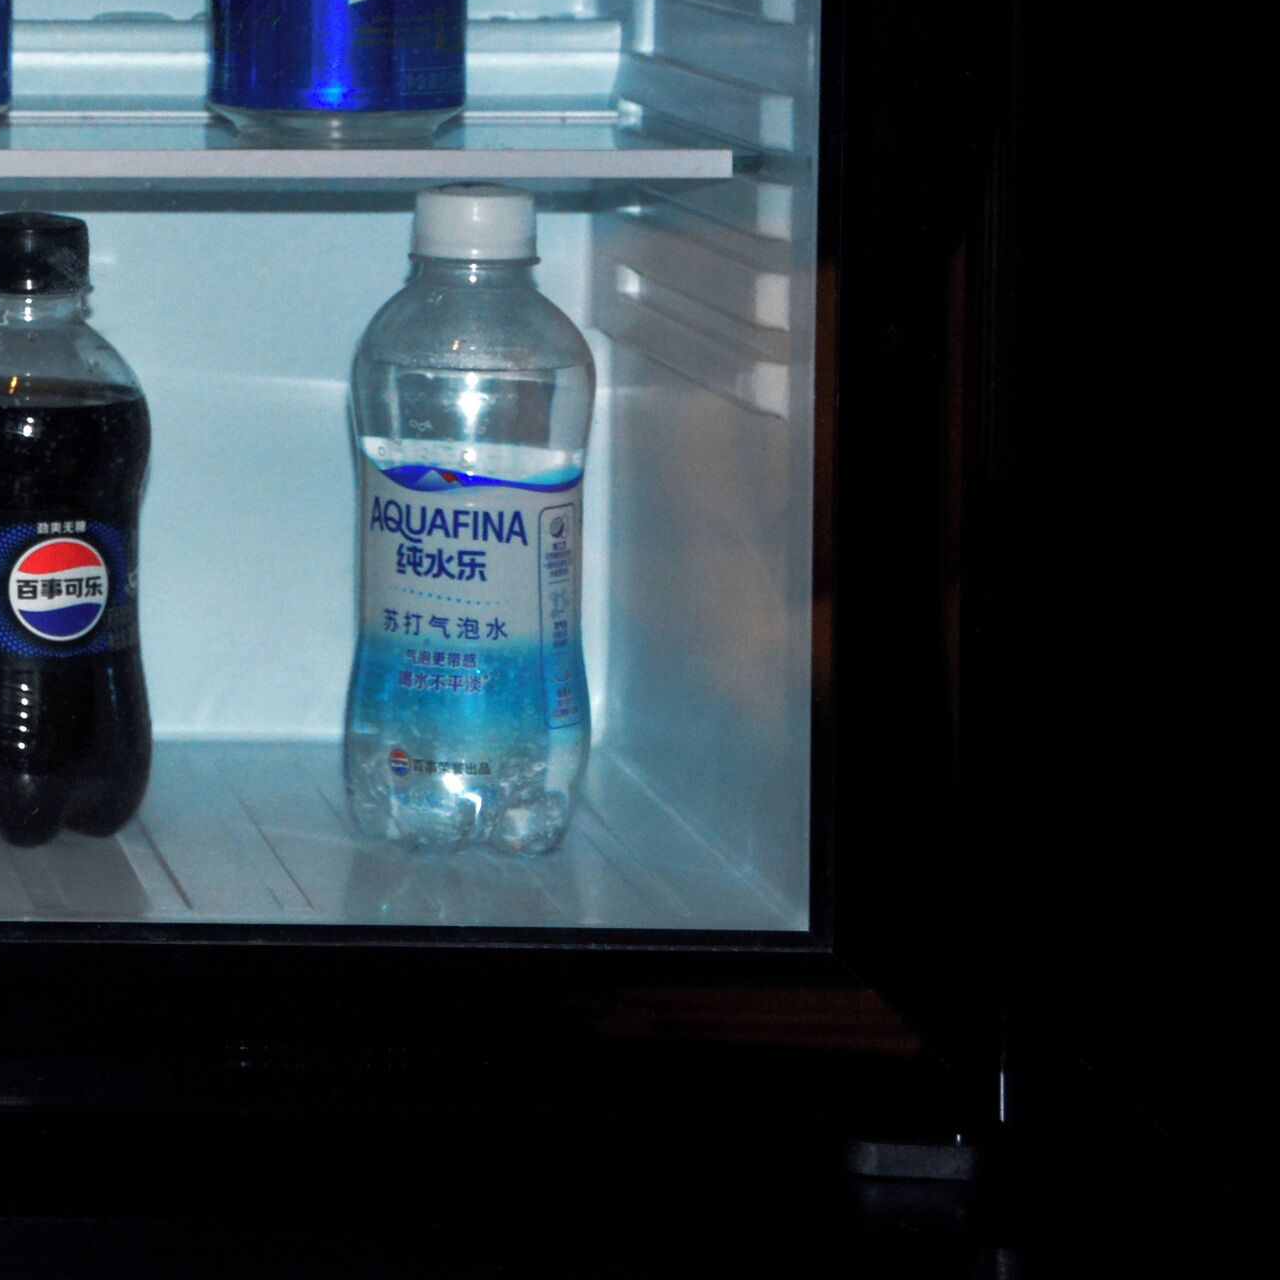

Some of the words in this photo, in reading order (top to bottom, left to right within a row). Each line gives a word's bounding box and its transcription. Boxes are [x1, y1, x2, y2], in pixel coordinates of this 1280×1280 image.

[370, 496, 529, 546] AQUAFINA
[396, 543, 488, 582] 纯水乐
[16, 575, 104, 601] 百事可乐
[383, 607, 509, 641] 苏打气泡水
[405, 648, 478, 669] 气泡更带感
